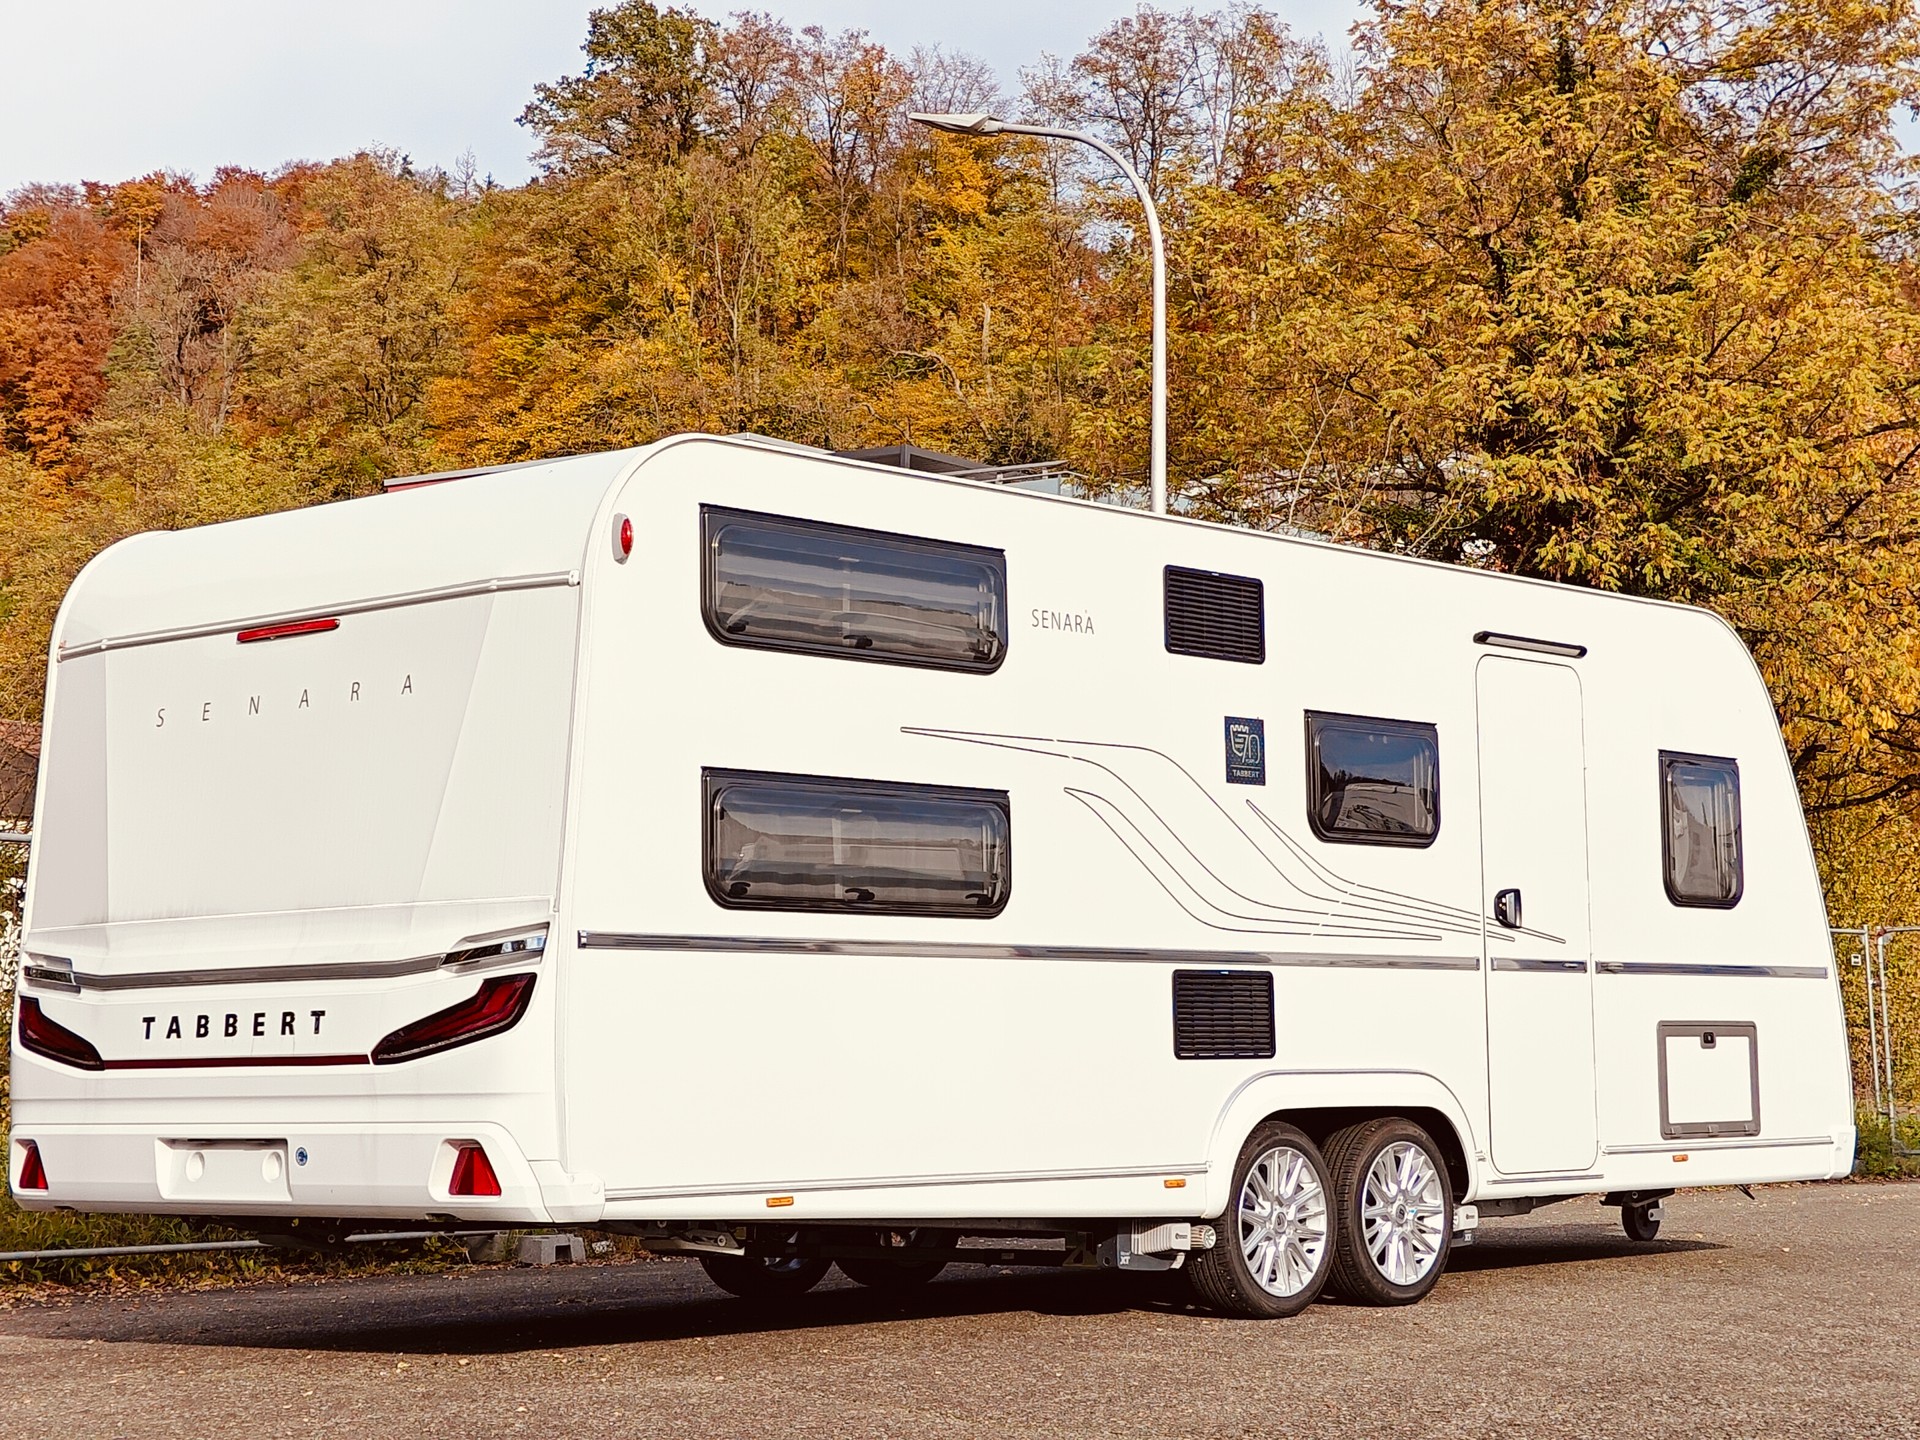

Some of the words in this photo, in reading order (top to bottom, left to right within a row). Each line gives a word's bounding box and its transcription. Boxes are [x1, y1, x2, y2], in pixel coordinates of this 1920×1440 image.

[1031, 609, 1094, 635] SENARA
[156, 674, 413, 727] SENARA
[1232, 769, 1260, 778] TABBERT
[142, 1010, 326, 1040] TABBERT
